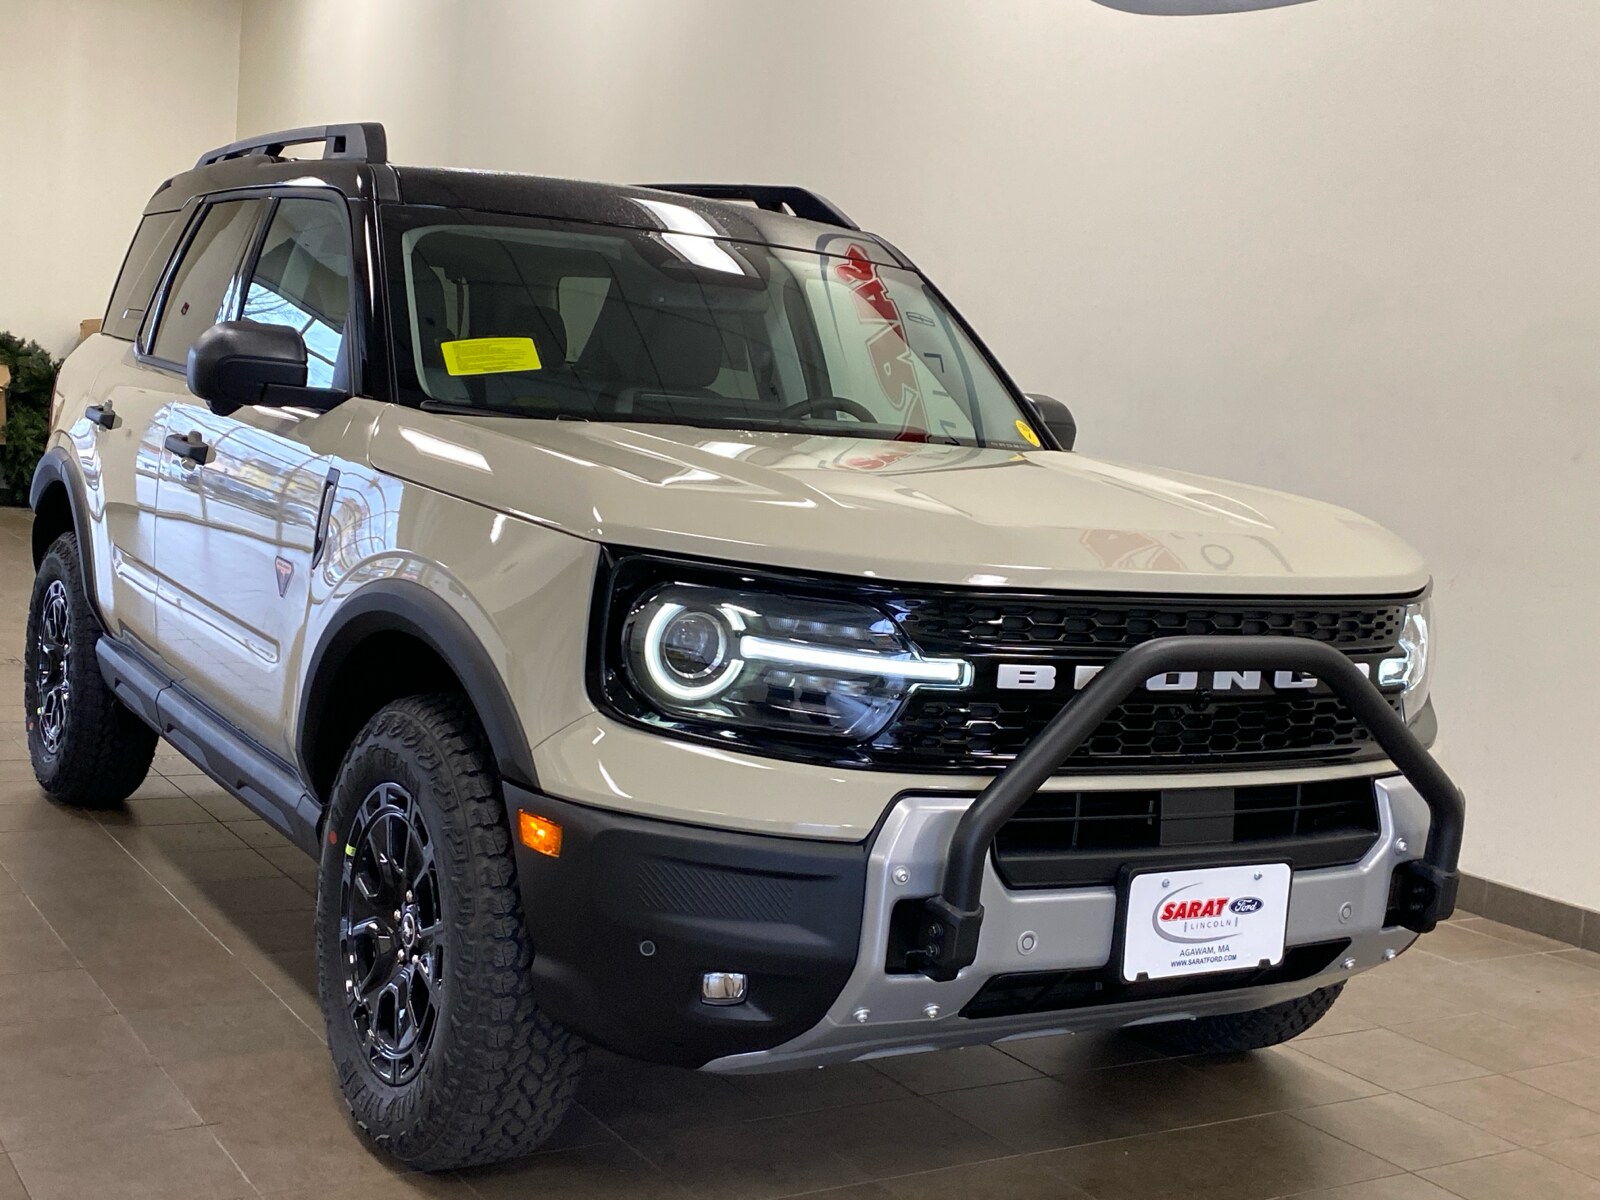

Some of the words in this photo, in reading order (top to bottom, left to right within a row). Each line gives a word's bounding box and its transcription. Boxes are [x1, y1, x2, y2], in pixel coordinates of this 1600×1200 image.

[996, 663, 1370, 691] BONC
[1161, 897, 1229, 921] SARAT
[1233, 898, 1259, 913] Ford
[1190, 919, 1231, 930] LINCOLN
[1179, 946, 1216, 957] AGAWAM,
[1217, 944, 1230, 953] MA
[1171, 954, 1237, 968] WWW.SARATFORD.COM
